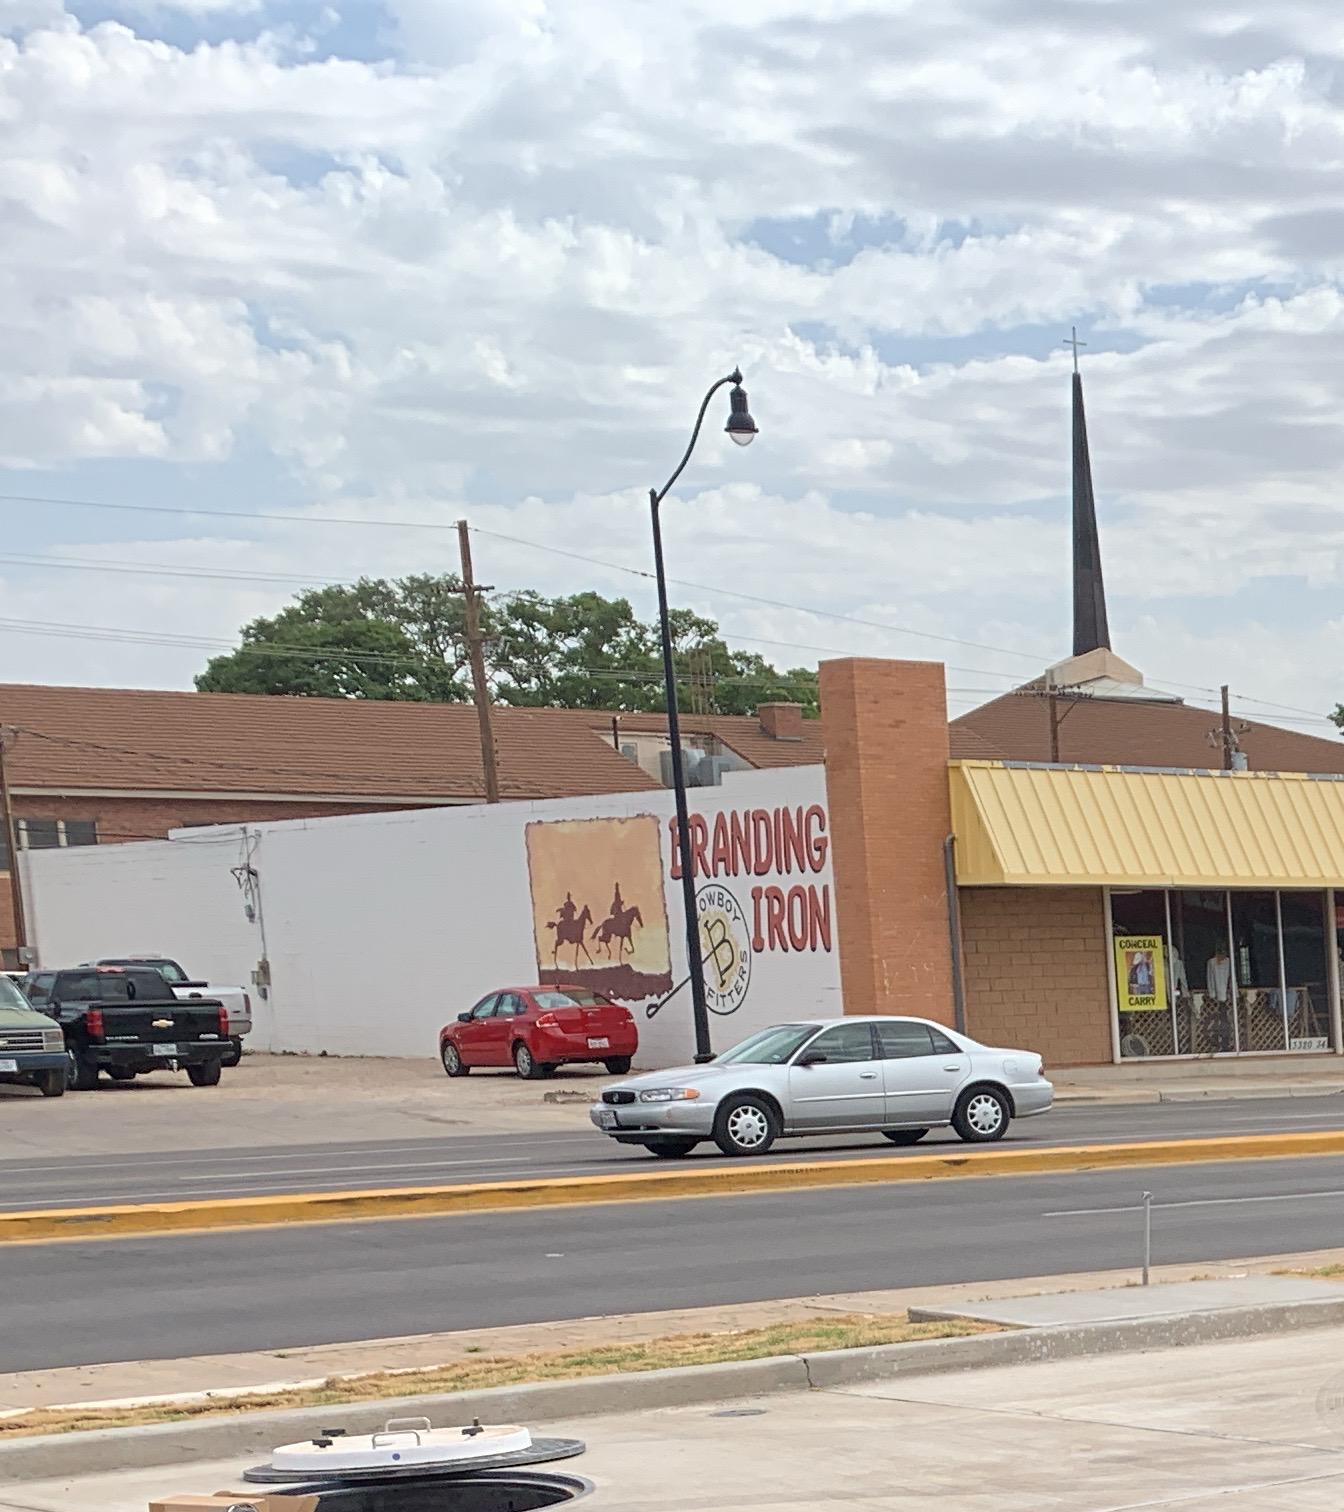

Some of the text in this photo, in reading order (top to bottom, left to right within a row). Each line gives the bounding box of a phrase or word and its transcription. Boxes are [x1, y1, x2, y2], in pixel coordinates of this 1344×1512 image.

[668, 804, 829, 880] BRANDING
[697, 890, 742, 923] OWBOY
[750, 884, 832, 953] IRON
[1119, 939, 1158, 949] CONCEAL
[703, 949, 748, 1008] FITTERS
[1128, 996, 1157, 1006] CARRY
